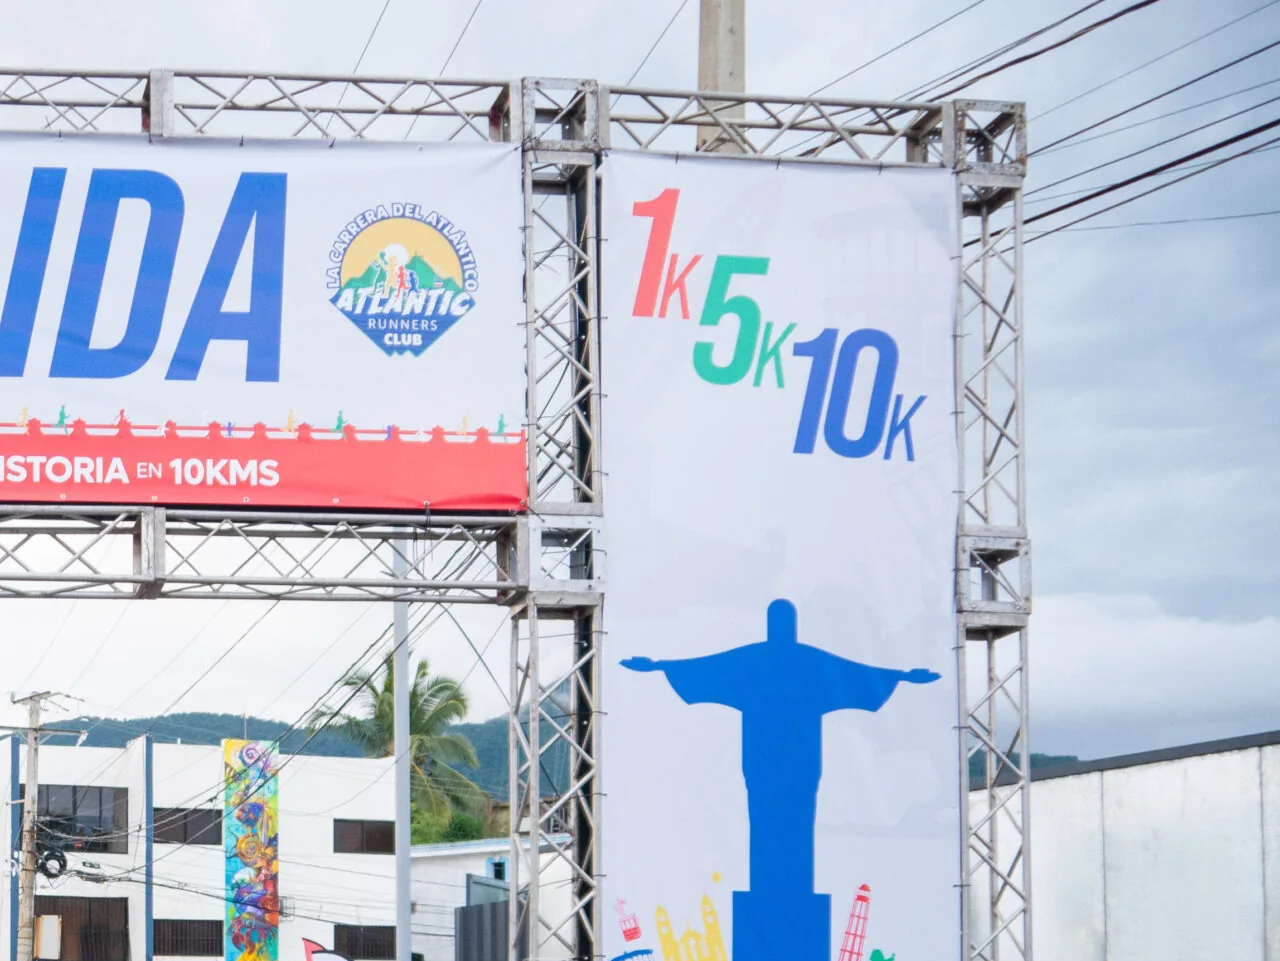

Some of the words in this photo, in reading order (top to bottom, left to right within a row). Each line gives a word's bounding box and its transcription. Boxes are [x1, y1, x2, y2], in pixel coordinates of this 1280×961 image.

[392, 203, 423, 219] DEL
[329, 205, 389, 263] CARRERA
[426, 211, 478, 292] ATLÁNTICO
[326, 267, 341, 289] LA
[336, 287, 471, 316] ATLANTIC
[368, 318, 438, 331] RUNNERS
[632, 188, 703, 320] 1K
[693, 254, 798, 389] 5K
[792, 328, 928, 462] 10K
[384, 333, 423, 346] CLUB
[136, 462, 162, 479] EN
[170, 458, 280, 487] 10KMS
